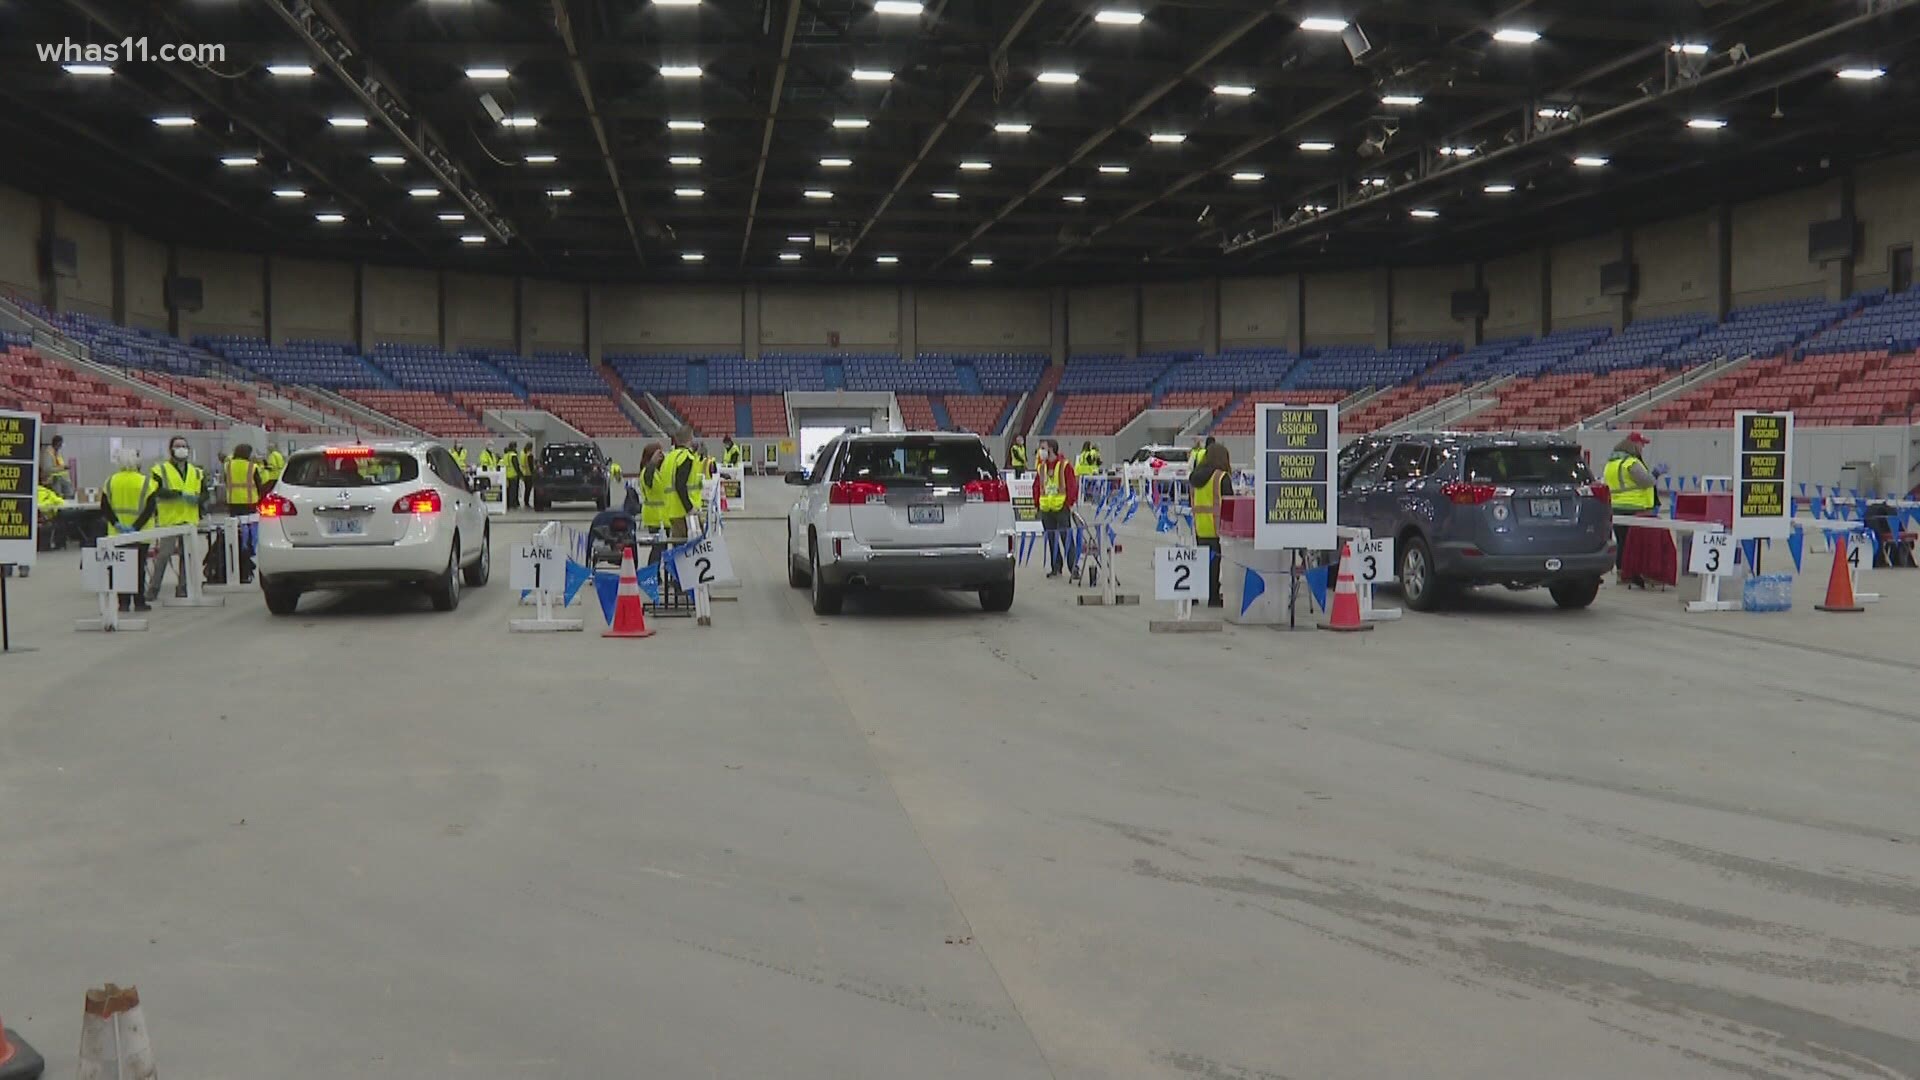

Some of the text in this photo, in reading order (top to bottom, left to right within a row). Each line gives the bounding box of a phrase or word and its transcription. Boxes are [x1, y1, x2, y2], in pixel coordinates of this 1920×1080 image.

[1282, 411, 1313, 422] STAY IN
[9, 419, 19, 430] IN
[1277, 424, 1317, 434] ASSIGNED
[1753, 418, 1776, 429] STAY IN
[1750, 429, 1779, 438] ASSIGNED
[1287, 435, 1307, 447] LANE
[1757, 439, 1771, 448] LANE
[1279, 455, 1315, 466] PROCEED
[1750, 457, 1777, 466] PROCEED
[1281, 467, 1314, 479] SLOWLY
[1751, 467, 1775, 476] SLOWLY
[1281, 487, 1313, 498] FOLLOW
[1751, 483, 1775, 494] FOLLOW
[1275, 498, 1317, 509] ARROW TO
[1748, 494, 1778, 504] ARROW TO
[1269, 509, 1324, 520] NEXT STATION
[1743, 504, 1781, 514] NEXT STATION
[11, 513, 22, 524] TO
[1703, 534, 1727, 546] LANE
[684, 541, 713, 558] LANE
[1356, 541, 1383, 553] LANE
[95, 551, 125, 562] LANE
[522, 547, 553, 560] LANE
[1167, 550, 1198, 561] LANE
[1848, 546, 1860, 568] 4
[1706, 549, 1719, 572] 3
[694, 557, 715, 584] 2
[1363, 556, 1377, 581] 3
[106, 565, 113, 590] 1
[533, 563, 541, 588] 1
[1174, 565, 1191, 591] 2
